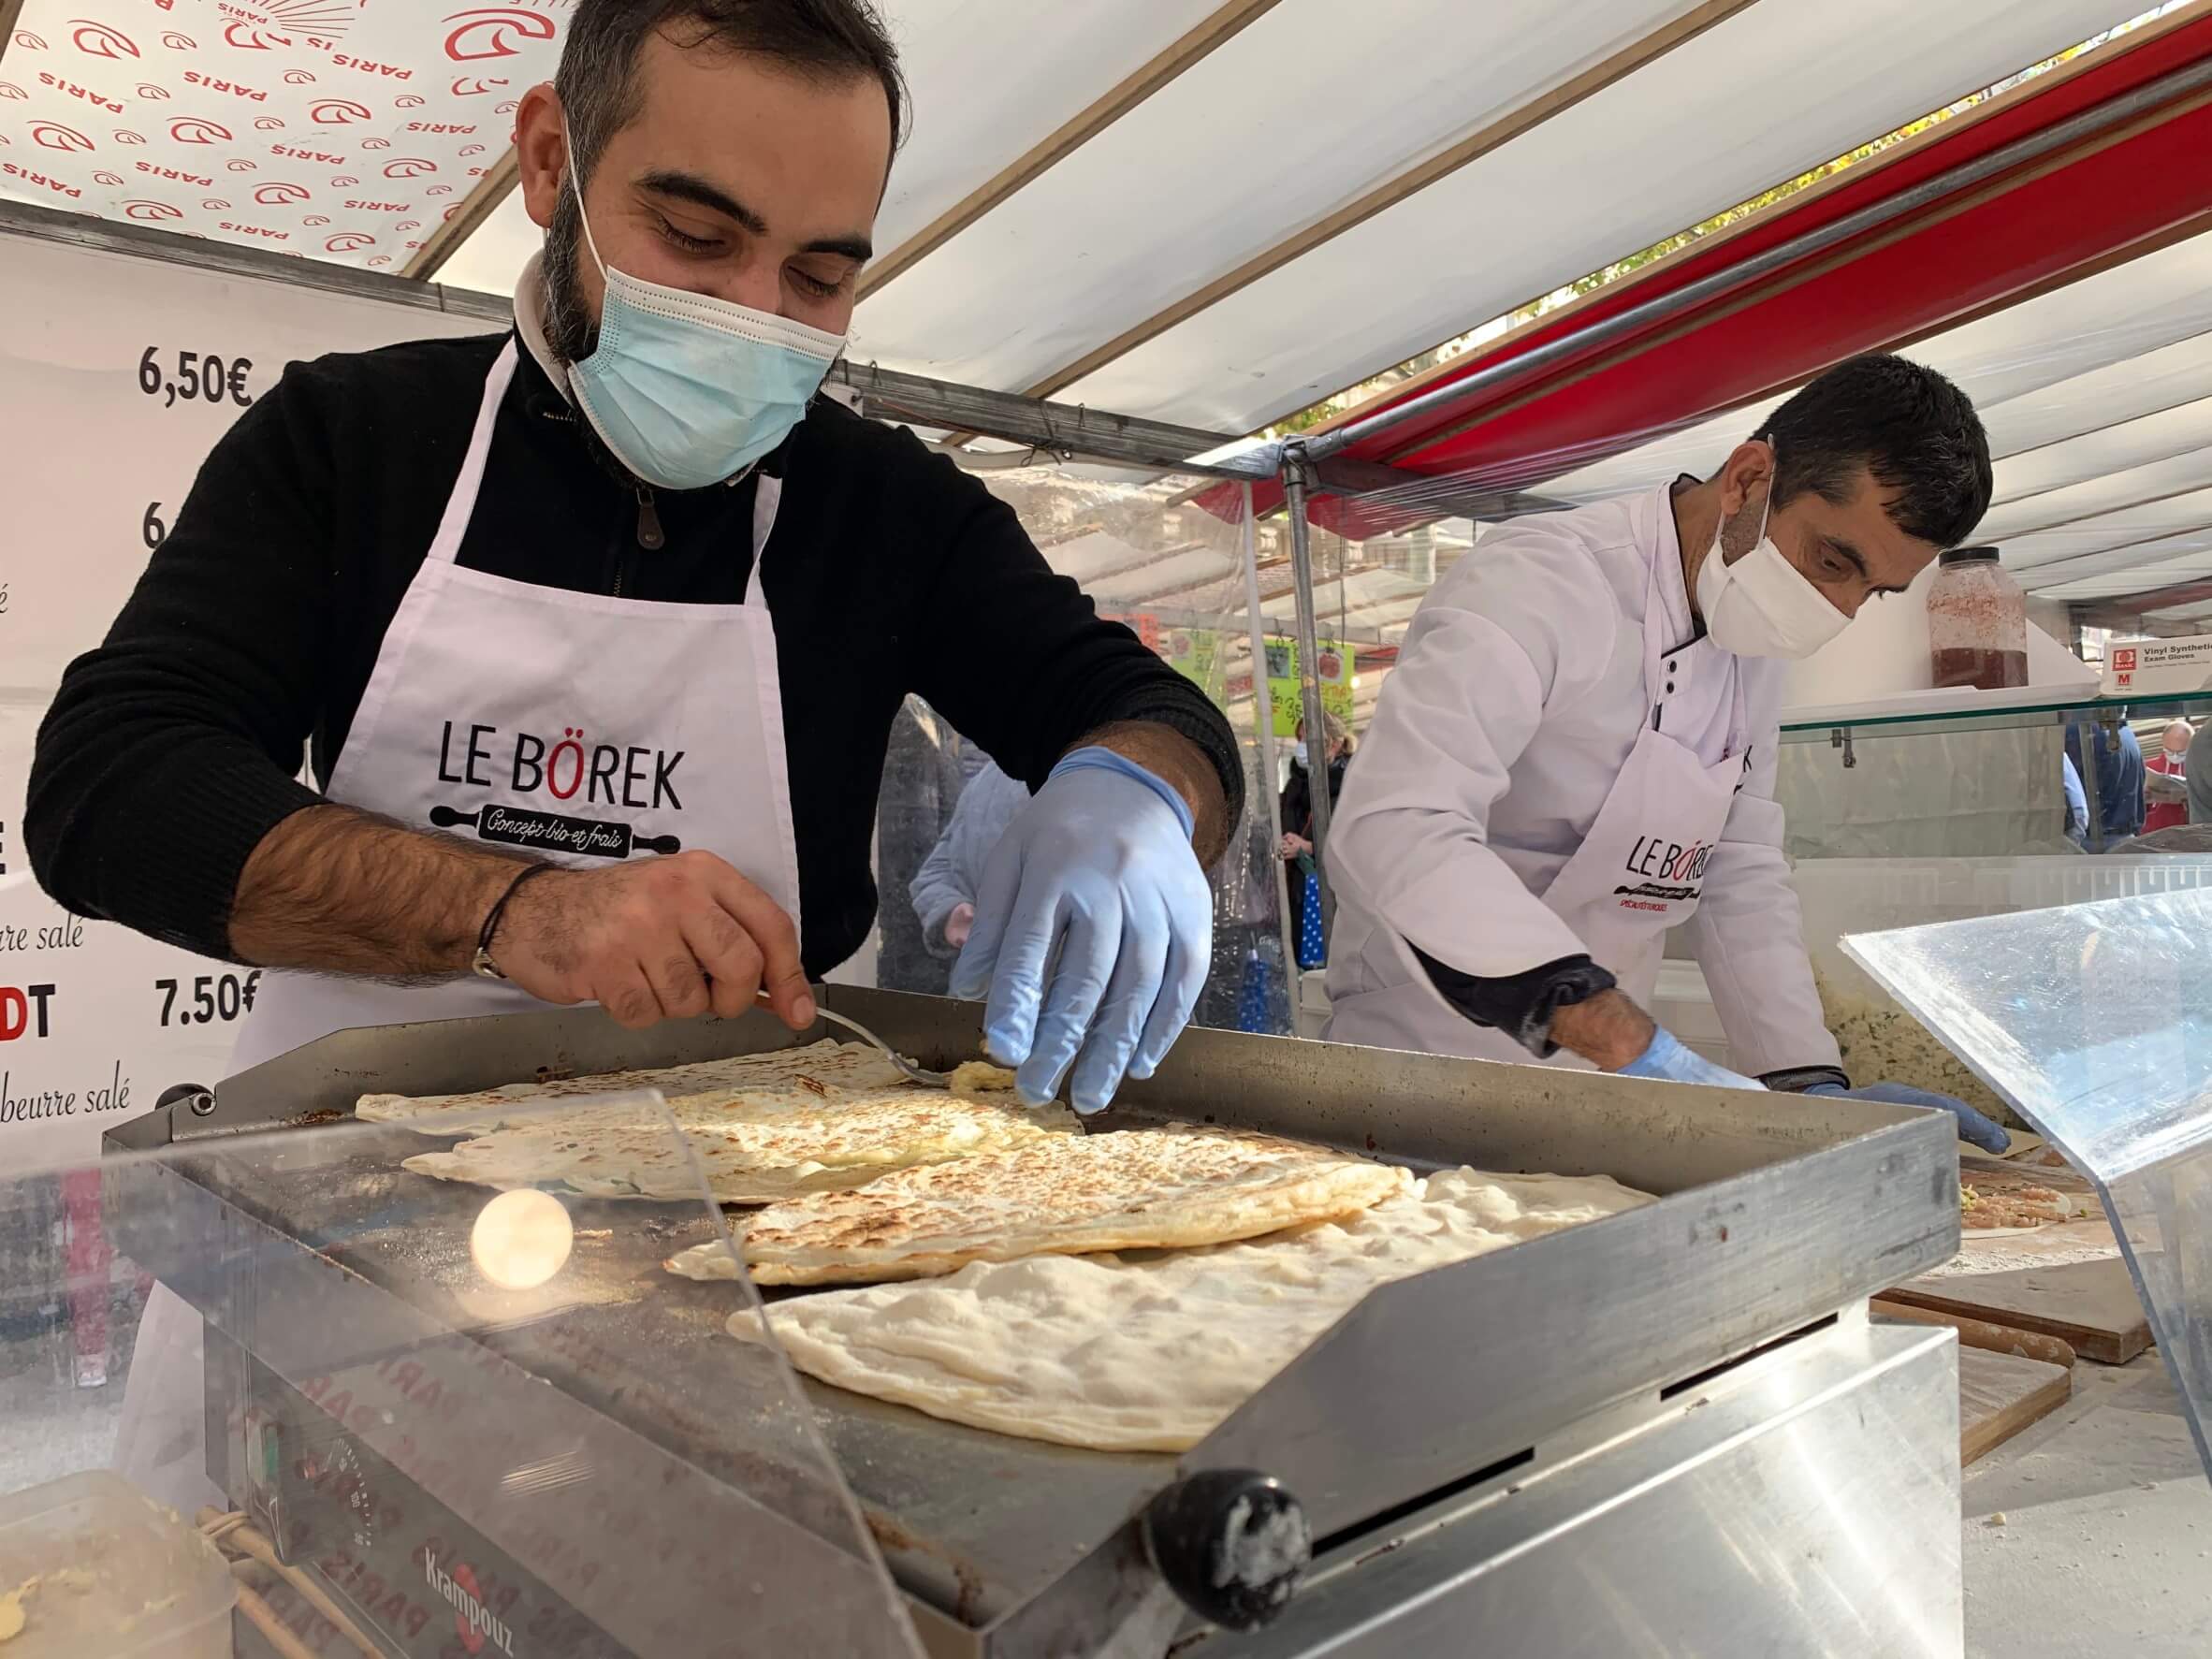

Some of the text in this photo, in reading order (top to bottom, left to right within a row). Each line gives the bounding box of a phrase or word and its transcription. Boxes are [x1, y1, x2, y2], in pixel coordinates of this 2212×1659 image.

[333, 53, 413, 81] PARIS
[38, 71, 124, 113] PARIS
[183, 70, 268, 102] PARIS
[406, 122, 476, 134] PARIS
[270, 144, 345, 164] PARIS
[3, 164, 81, 198] PARIS
[136, 161, 213, 187] PARIS
[344, 200, 411, 212] PARIS
[219, 222, 289, 240] PARIS
[138, 346, 254, 407] 6,50€
[2144, 647, 2167, 656] Vinyl
[2118, 674, 2131, 684] M
[438, 720, 685, 810] LE BÖREK
[1625, 836, 1663, 876] LE
[36, 912, 83, 950] salé
[0, 1059, 130, 1124] beurre salé
[425, 1547, 515, 1658] Krampouz
